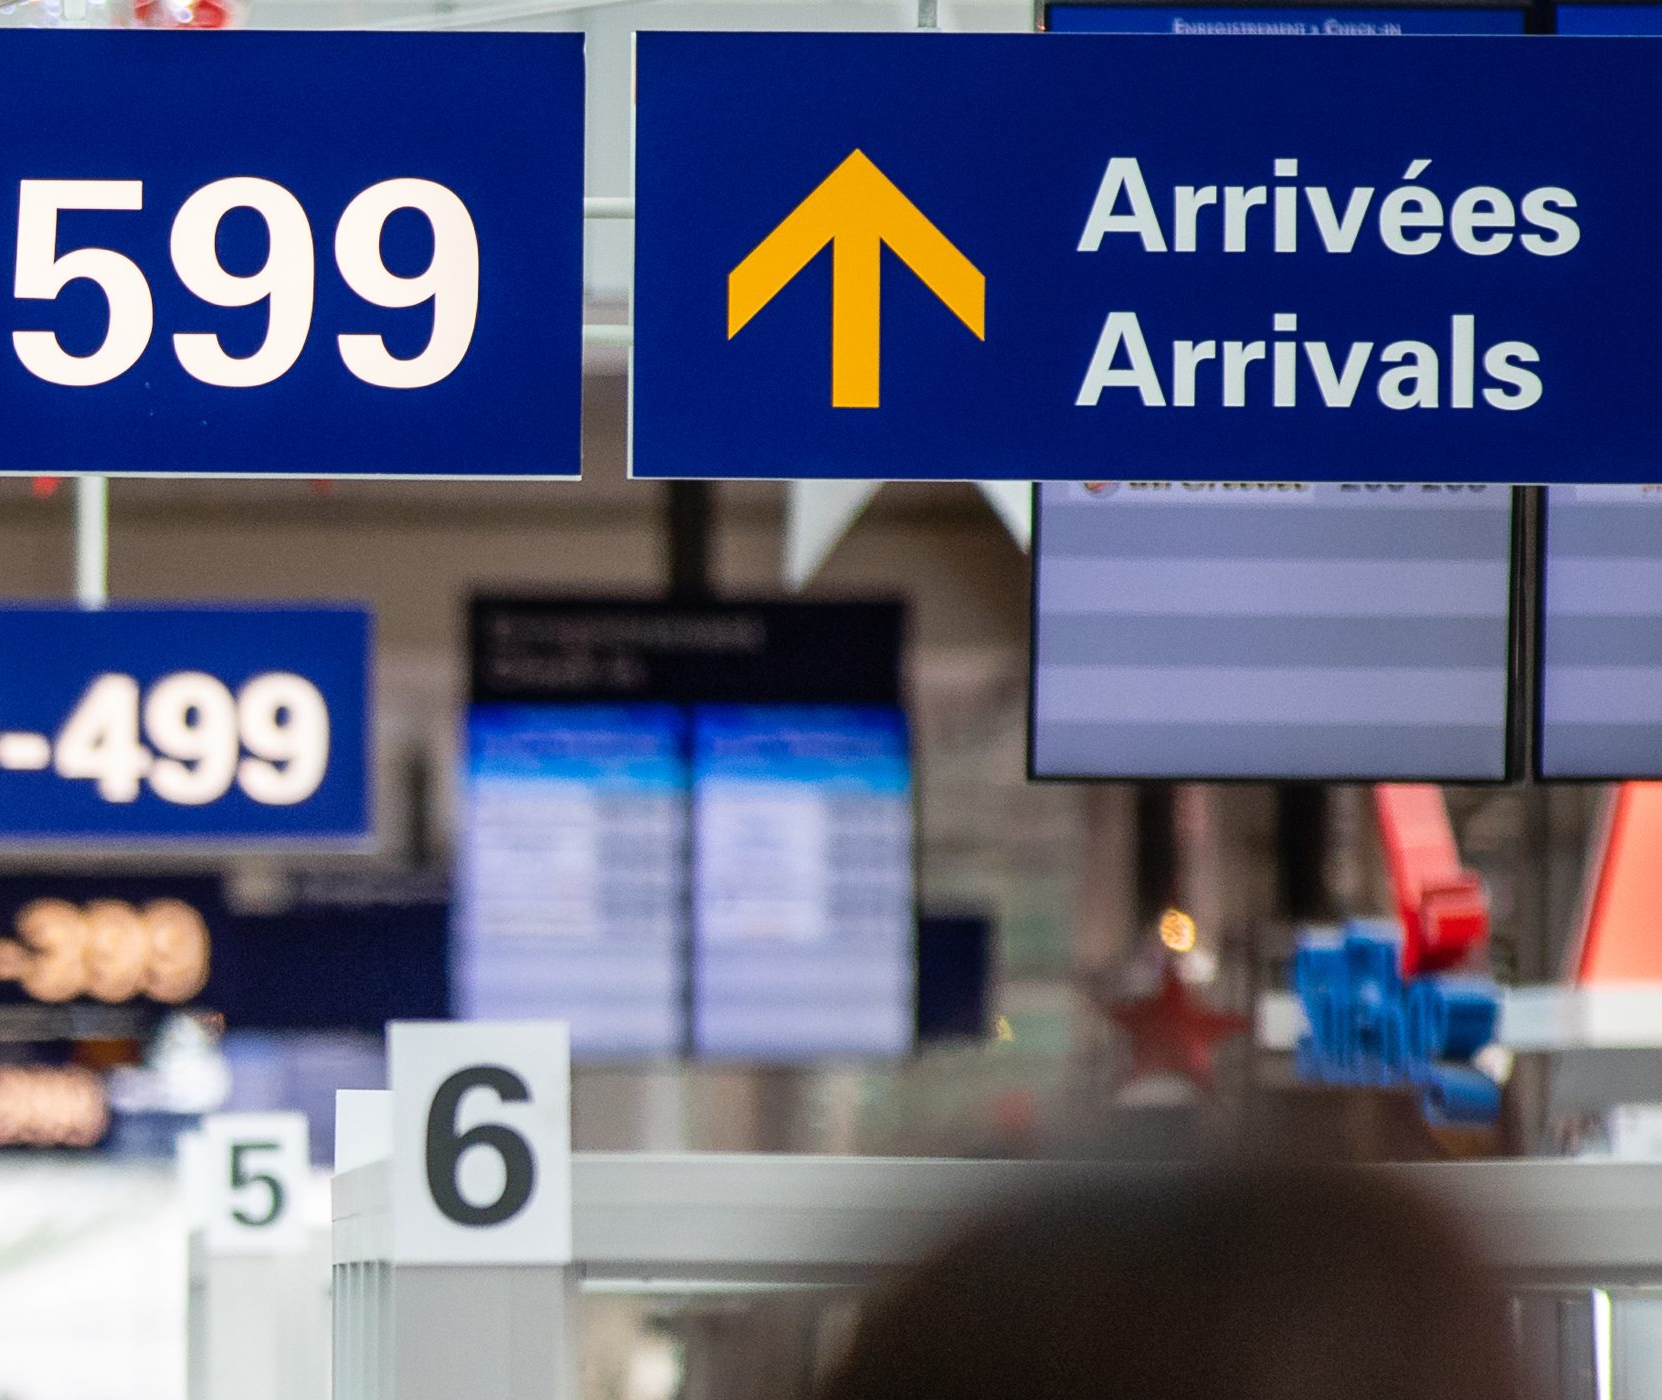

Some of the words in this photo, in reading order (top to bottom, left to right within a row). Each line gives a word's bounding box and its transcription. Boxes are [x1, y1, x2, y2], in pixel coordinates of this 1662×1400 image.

[1076, 156, 1582, 257] Arrivées
[1075, 311, 1544, 411] Arrivals
[229, 1140, 285, 1226] 5
[424, 1064, 535, 1228] 6
